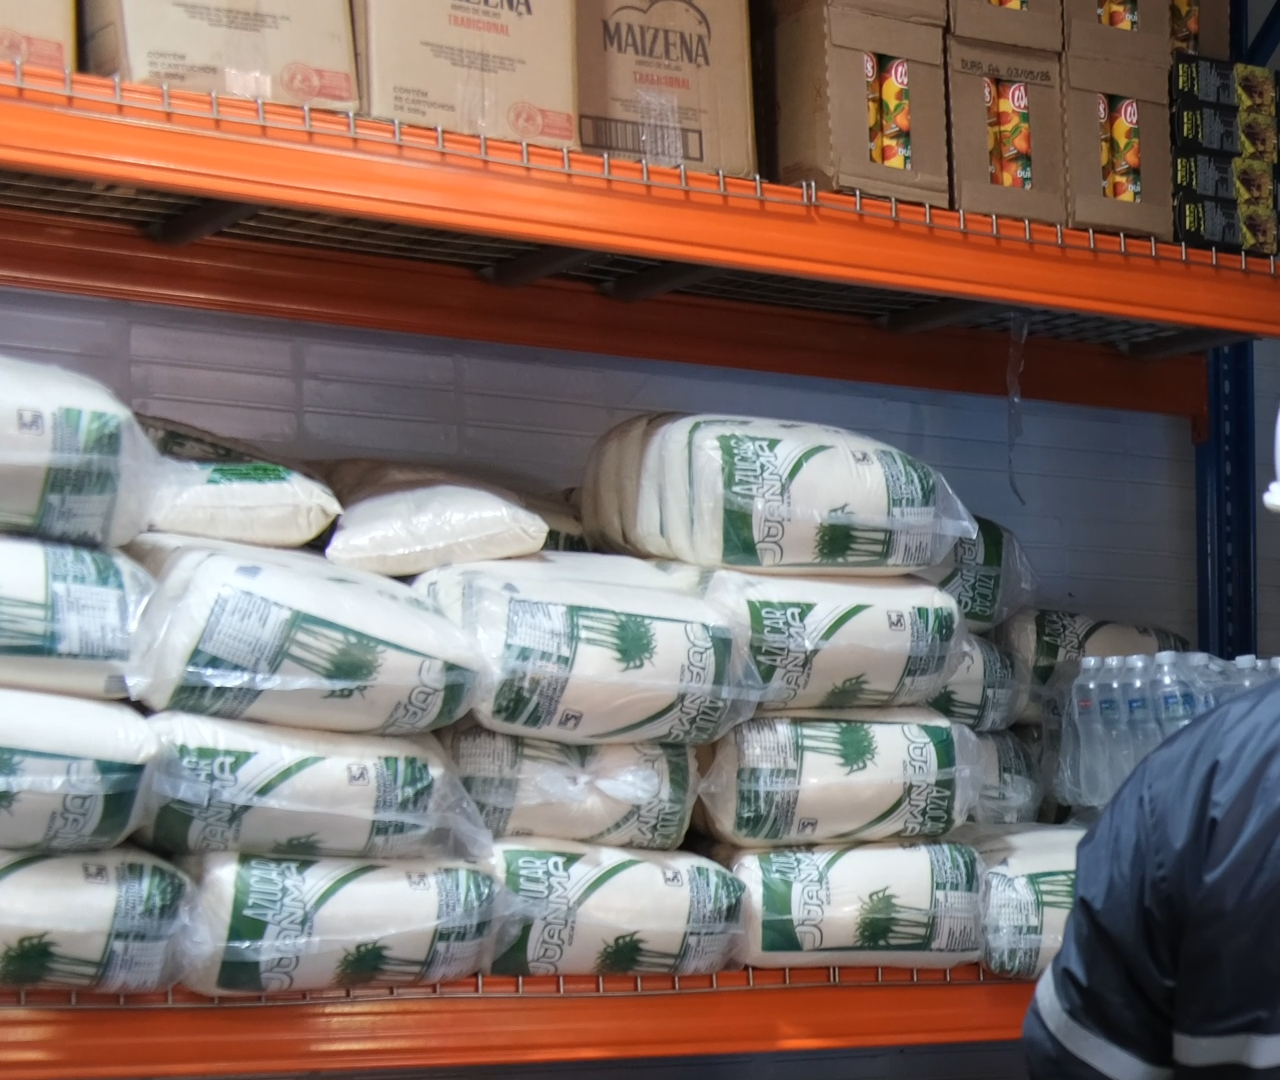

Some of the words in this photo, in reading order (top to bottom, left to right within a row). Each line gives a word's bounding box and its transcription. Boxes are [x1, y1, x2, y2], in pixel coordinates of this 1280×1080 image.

[447, 14, 511, 37] TRADICIONAL
[601, 18, 711, 69] MAIZENA
[632, 71, 691, 91] TRADICIONAL
[756, 606, 787, 669] AZUCAR
[901, 723, 931, 837] JUANMA
